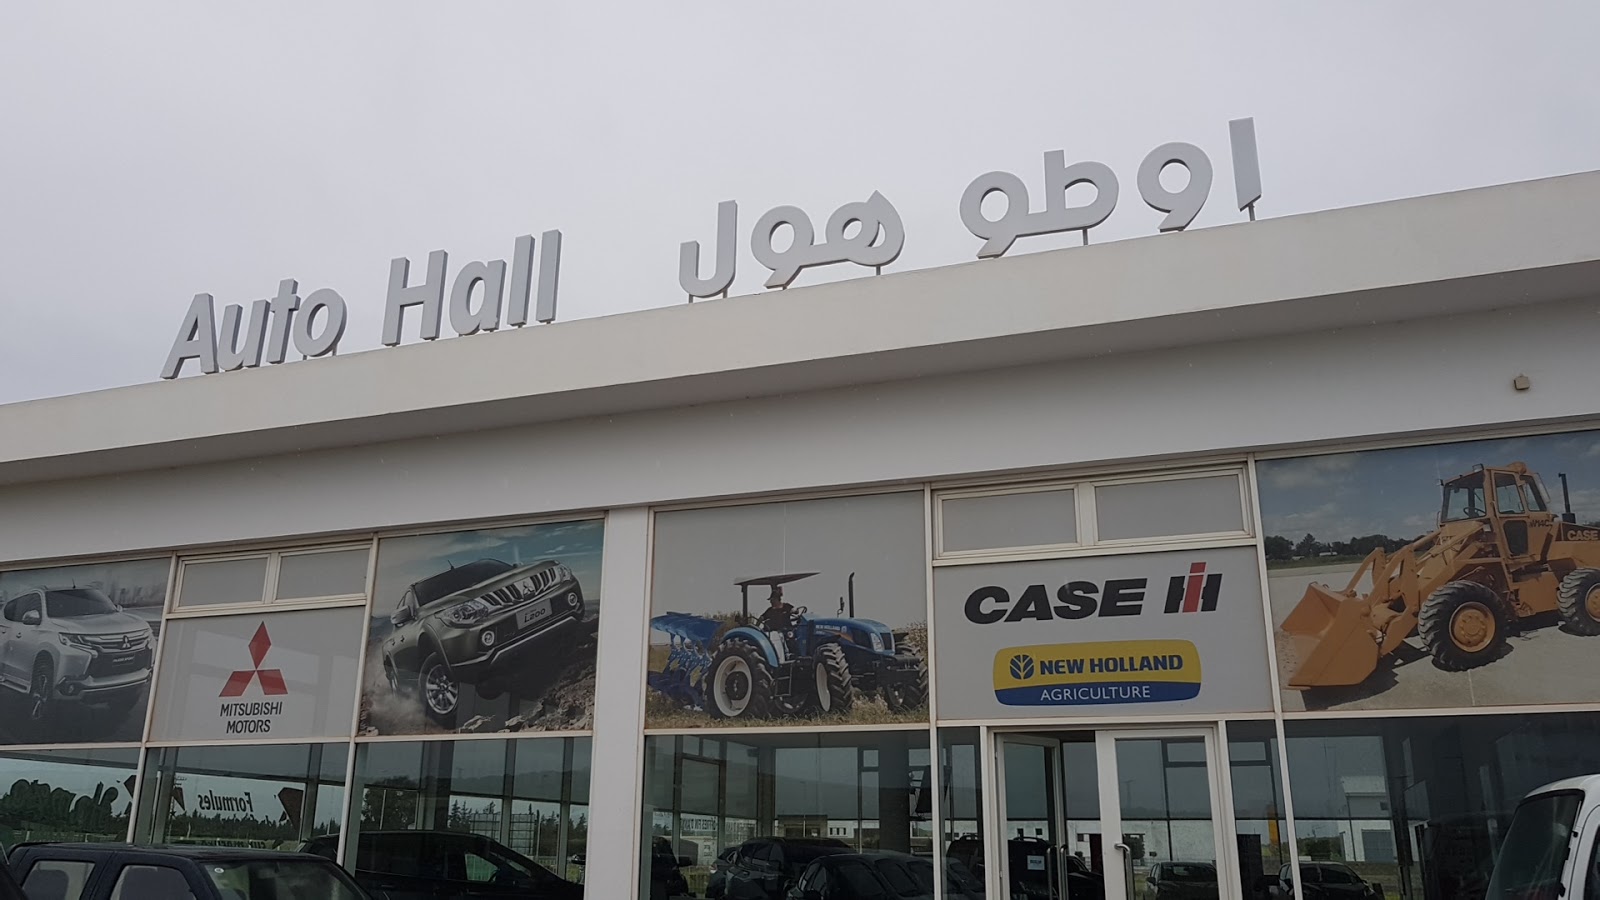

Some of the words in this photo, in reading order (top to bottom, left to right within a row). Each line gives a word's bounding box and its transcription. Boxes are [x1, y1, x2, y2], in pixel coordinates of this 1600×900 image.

[679, 189, 905, 298] هول
[160, 278, 347, 379] Auto
[382, 229, 562, 346] Hall
[1567, 529, 1599, 541] CASE
[964, 578, 1147, 624] CASE
[524, 608, 545, 622] L200
[1040, 658, 1085, 675] NEW
[1090, 654, 1183, 673] HOLLAND
[1040, 685, 1151, 701] AGRICULTURE
[220, 701, 283, 717] MITSUBISHI
[226, 719, 271, 733] MOTORS
